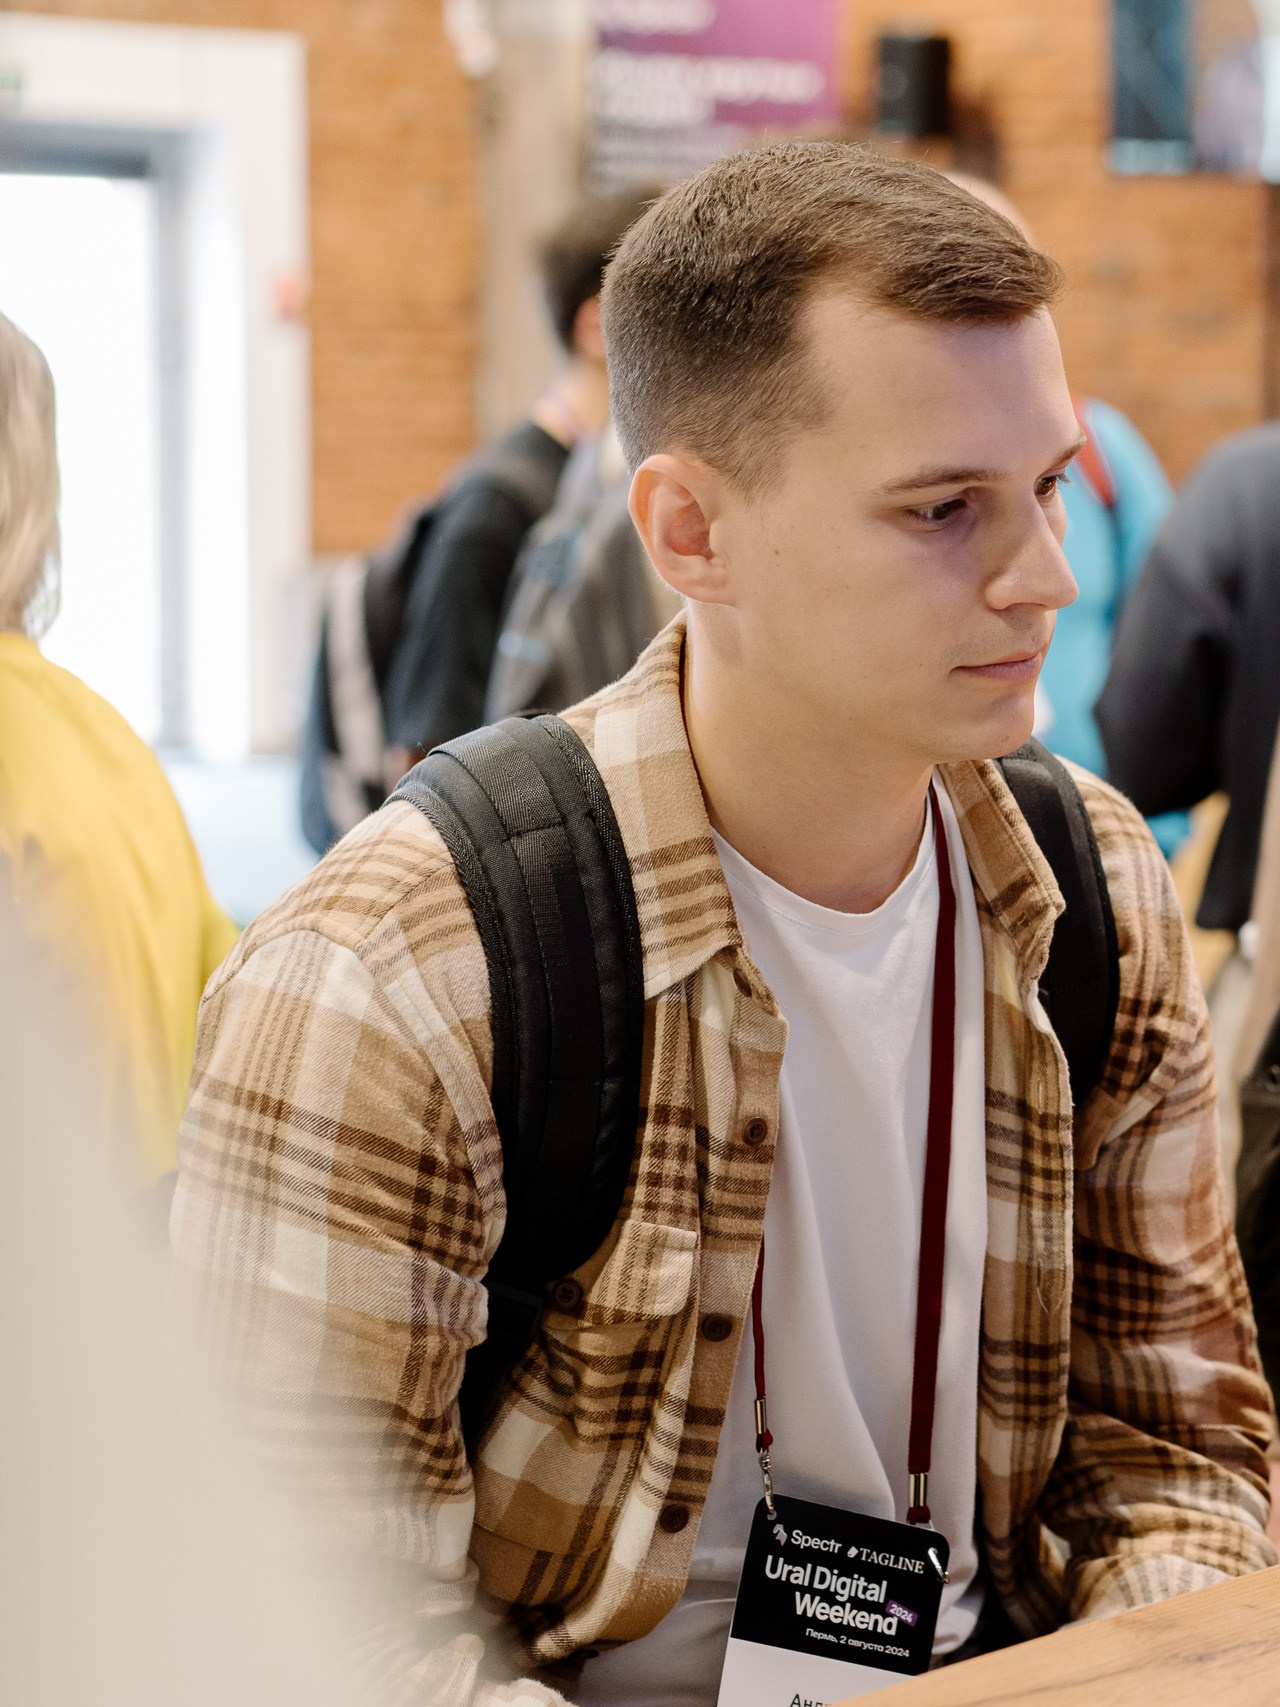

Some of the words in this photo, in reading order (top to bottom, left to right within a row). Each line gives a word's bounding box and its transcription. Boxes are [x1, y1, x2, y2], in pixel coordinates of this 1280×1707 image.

[790, 1529, 842, 1554] Spectr
[860, 1547, 925, 1574] TAGLINE
[764, 1554, 811, 1587] Ural
[813, 1565, 888, 1603] Digital
[794, 1591, 898, 1636] Weekend
[889, 1603, 913, 1623] 2024
[805, 1627, 838, 1643] Пермь,
[839, 1635, 847, 1644] 2
[847, 1638, 884, 1652] августа
[884, 1645, 910, 1658] 2024
